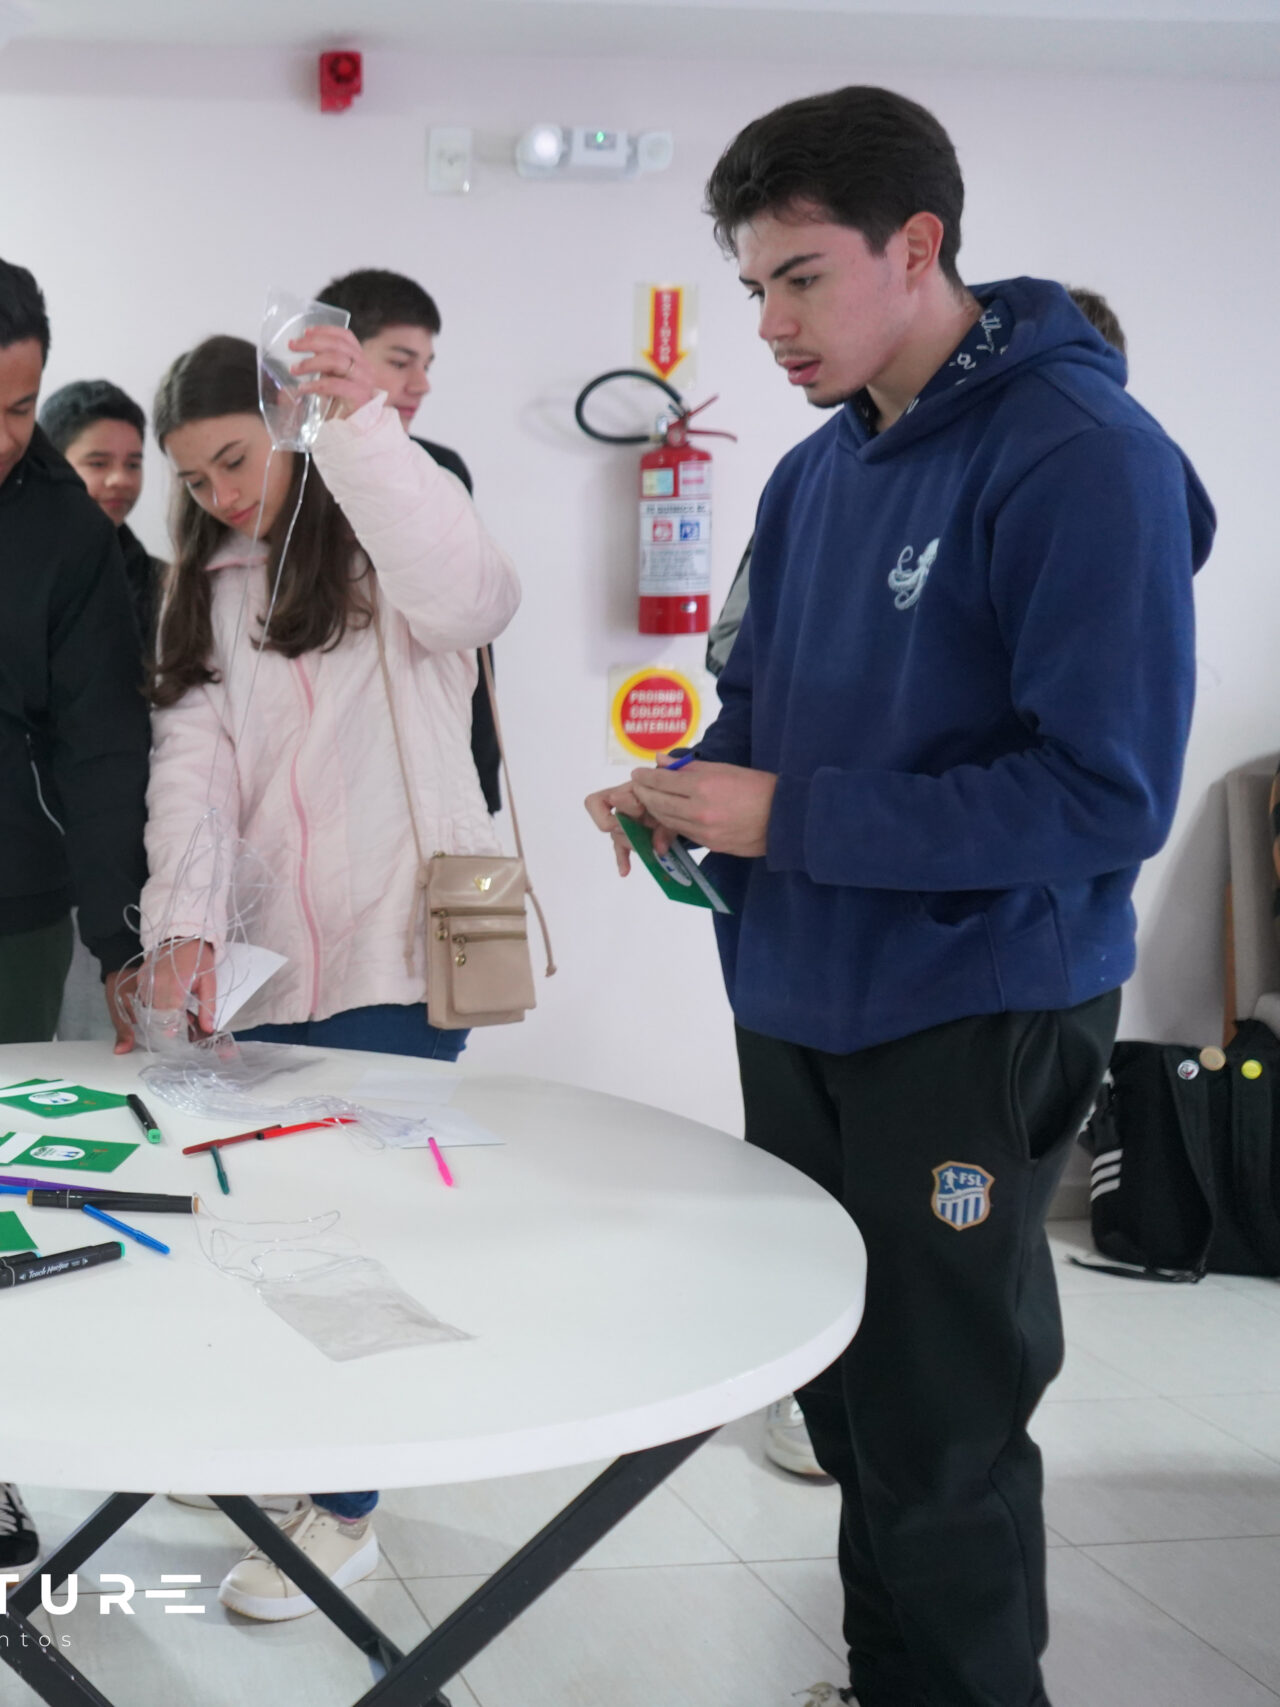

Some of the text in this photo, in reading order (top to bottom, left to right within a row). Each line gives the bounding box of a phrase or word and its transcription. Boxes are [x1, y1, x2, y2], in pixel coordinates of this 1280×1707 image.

[630, 690, 684, 704] PROIBIDO
[629, 704, 682, 719] COLOCAR
[624, 719, 687, 733] MATERIAIS
[959, 1172, 983, 1187] FSL
